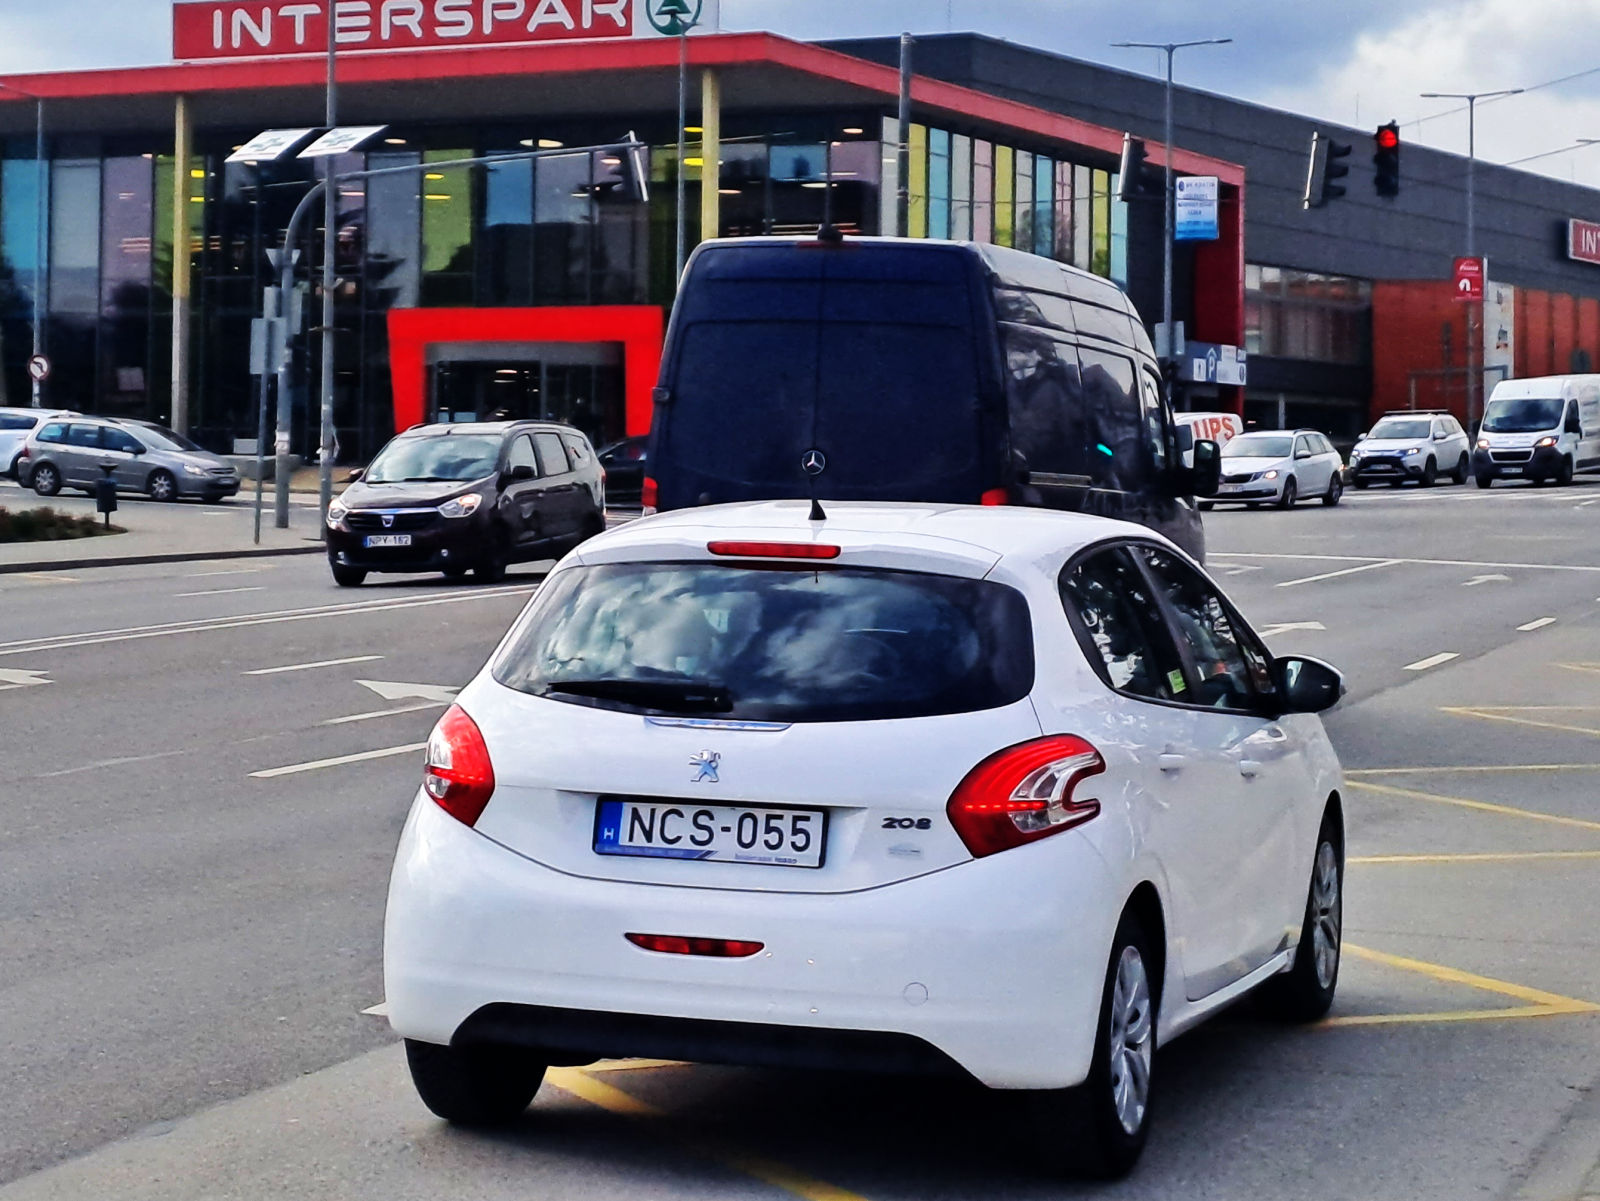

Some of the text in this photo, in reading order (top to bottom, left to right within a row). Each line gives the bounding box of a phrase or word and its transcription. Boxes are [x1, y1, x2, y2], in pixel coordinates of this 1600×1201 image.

[212, 0, 627, 50] INTERSPAR
[603, 806, 811, 852] H NCS-055
[881, 817, 932, 830] 208
